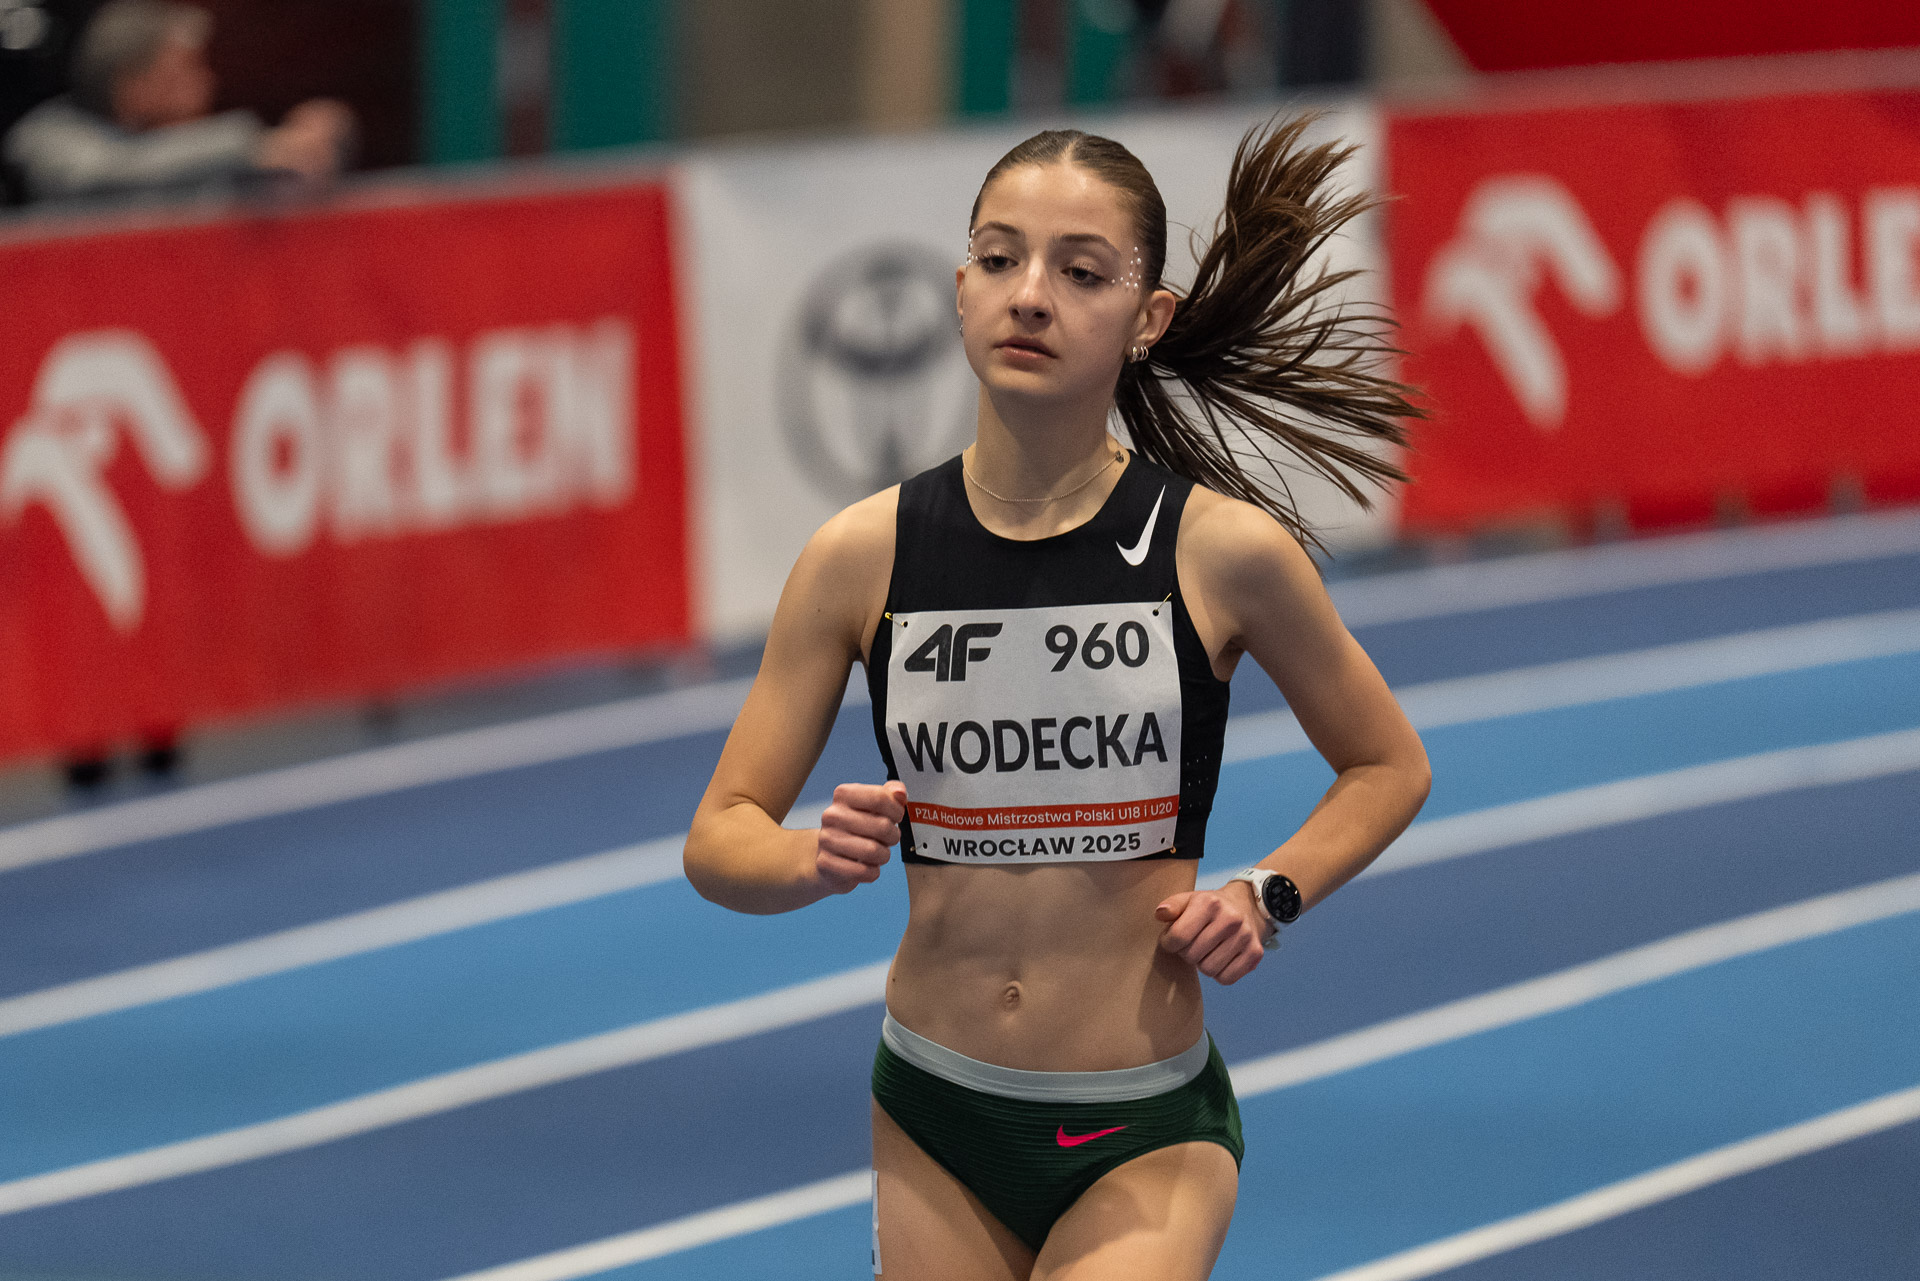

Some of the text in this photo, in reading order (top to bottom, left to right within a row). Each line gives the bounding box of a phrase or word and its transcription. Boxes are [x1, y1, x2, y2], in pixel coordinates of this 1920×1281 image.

[230, 319, 637, 556] ORLEN
[904, 622, 1003, 682] 4F
[1045, 620, 1150, 673] 960
[897, 711, 1168, 774] WODECKA
[915, 801, 1173, 826] PZLA Halowe Mistrzostwa Polski U18 i U20
[943, 832, 1141, 857] WROCŁAW 2025
